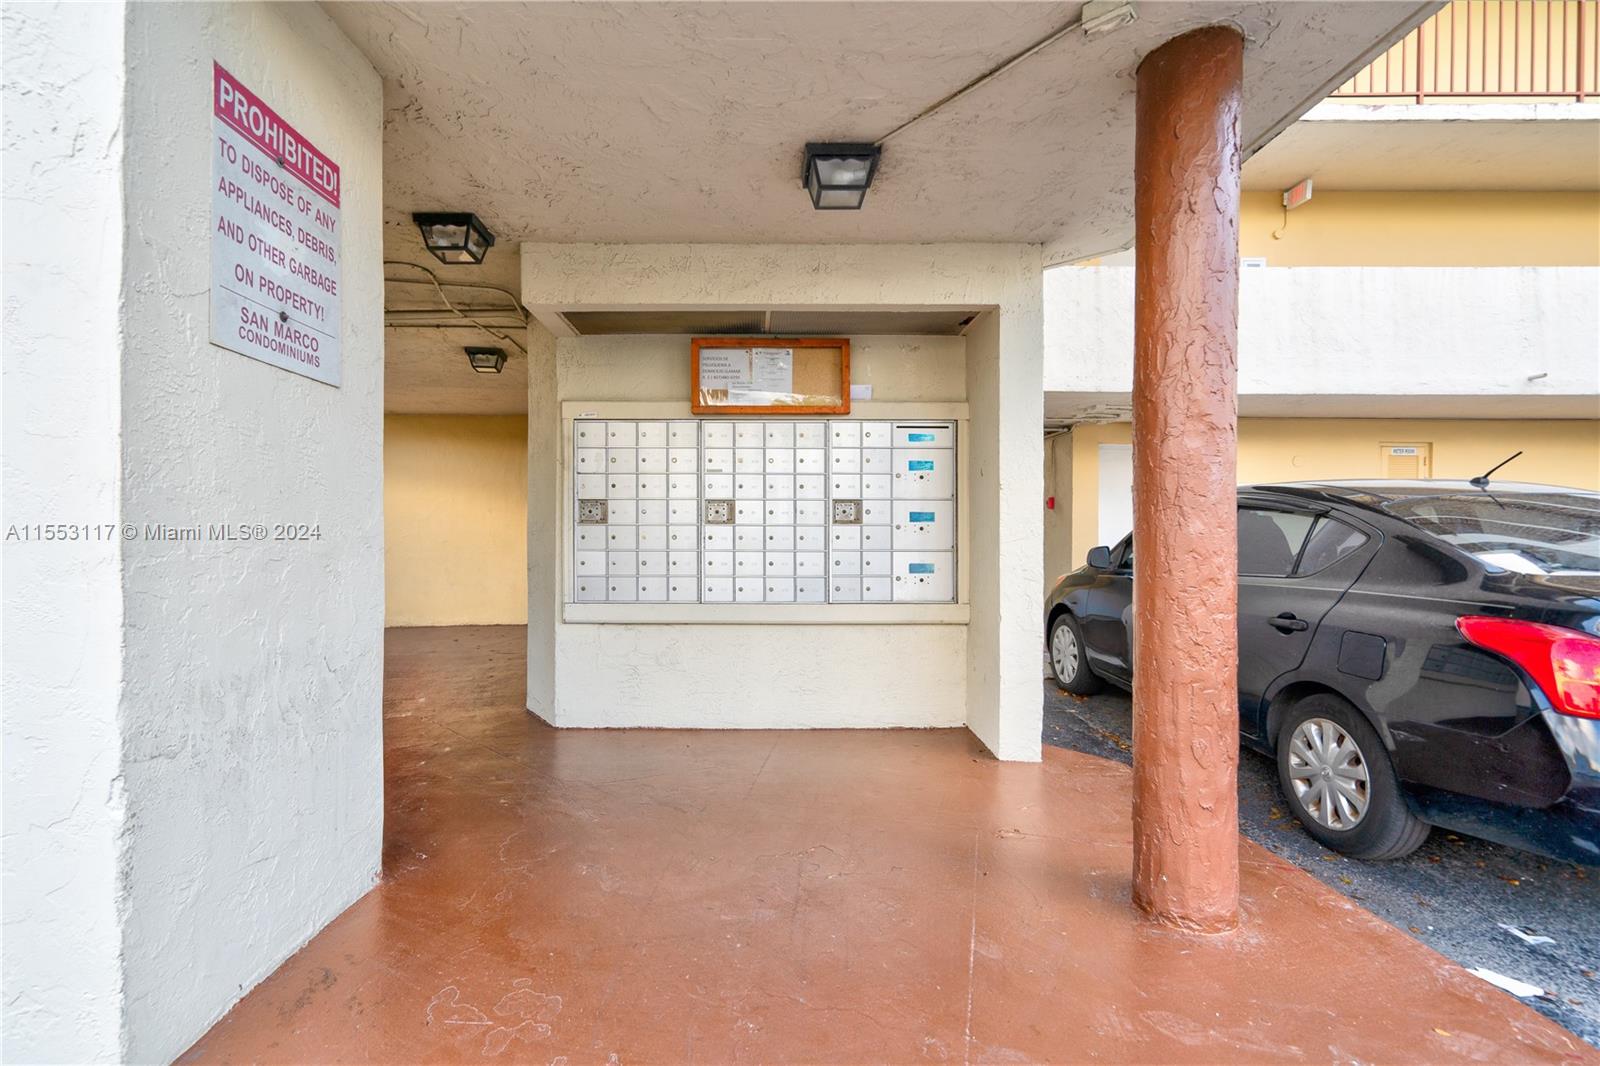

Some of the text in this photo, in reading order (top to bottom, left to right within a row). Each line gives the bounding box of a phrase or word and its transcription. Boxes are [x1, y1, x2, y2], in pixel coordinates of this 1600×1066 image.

[219, 78, 338, 196] PROHIBITED!
[218, 176, 337, 265] APPLIANCES, DEBRIS,
[219, 137, 336, 233] TO DISPOSE OF ANY
[217, 215, 337, 296] AND OTHER GARBAGE
[235, 264, 325, 322] ON PROPERTY!
[238, 326, 320, 368] CONDOMINIUMS
[240, 306, 319, 352] SAN MARCO
